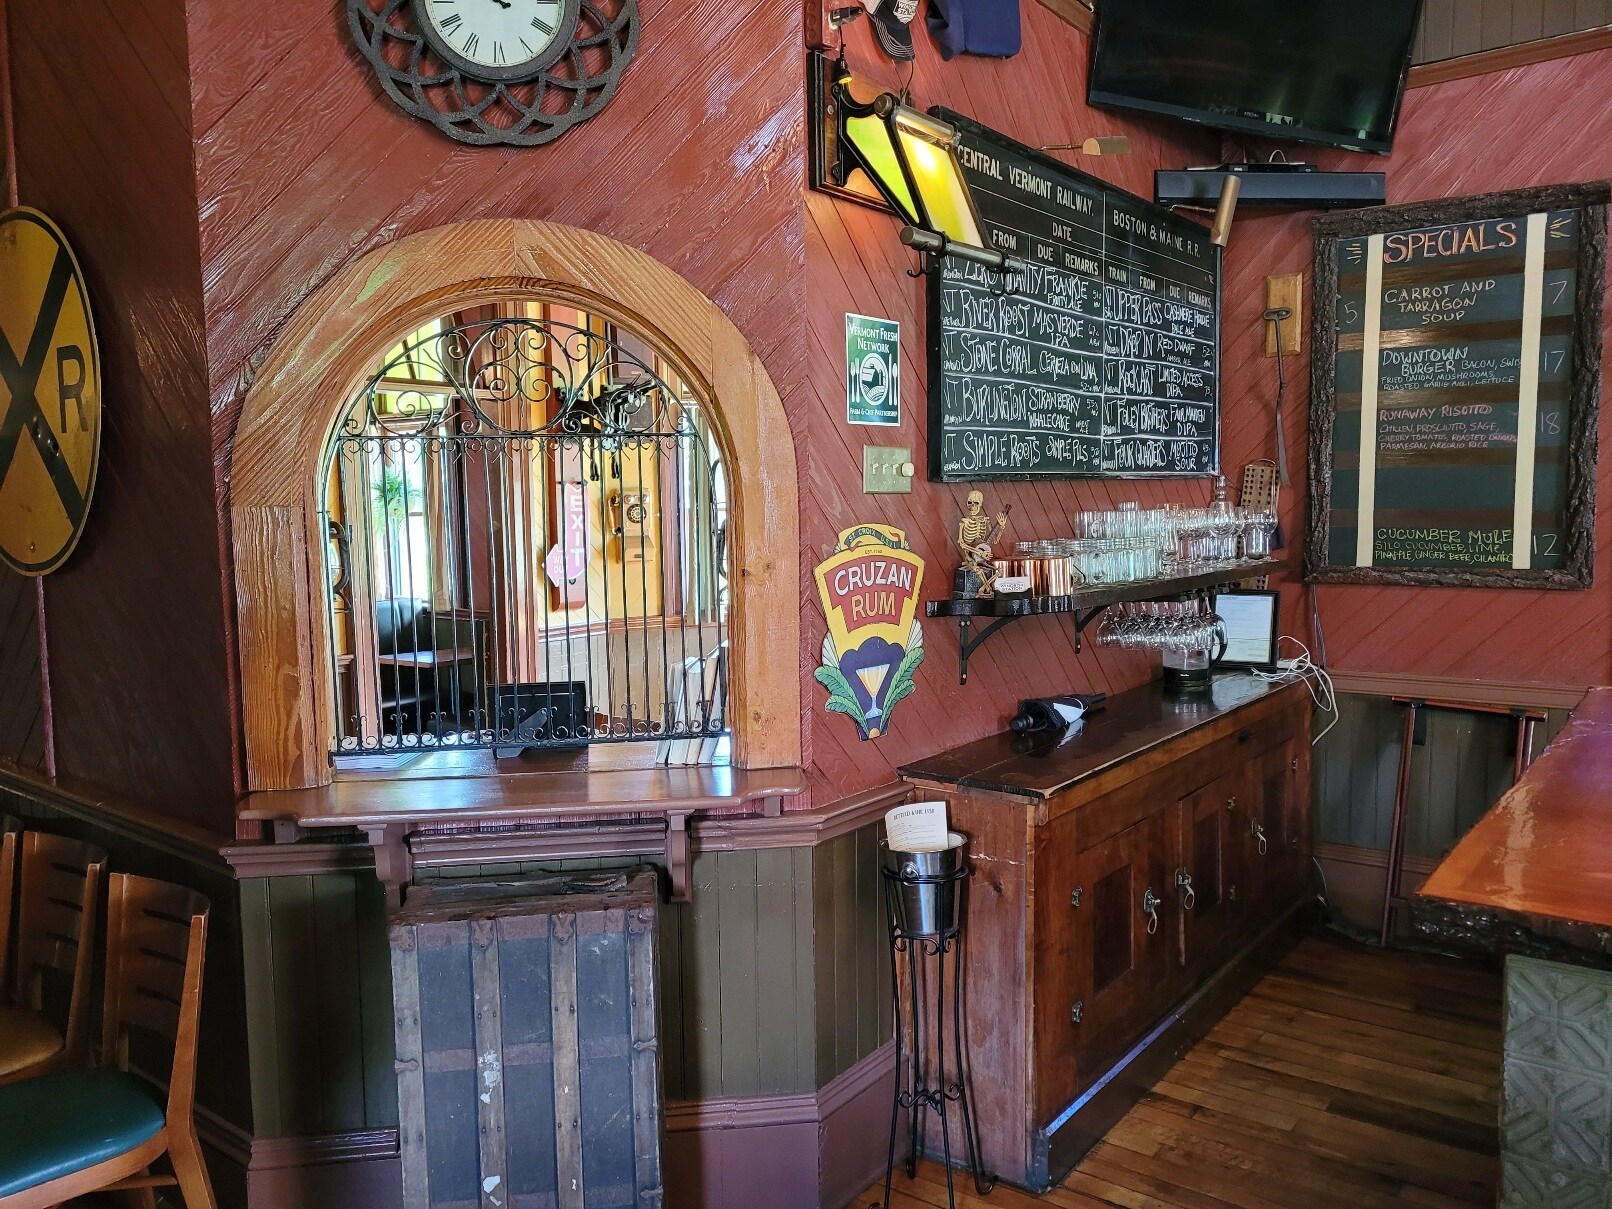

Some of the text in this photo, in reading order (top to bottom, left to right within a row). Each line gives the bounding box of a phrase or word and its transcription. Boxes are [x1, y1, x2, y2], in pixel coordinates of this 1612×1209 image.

[957, 144, 1003, 180] CENTRAL
[1008, 165, 1052, 200] VERMONT
[1052, 222, 1072, 242] DATE
[1113, 210, 1147, 236] BOSTON
[1150, 225, 1158, 240] &
[1160, 229, 1184, 252] MAINE
[1383, 222, 1517, 264] SPECIALS
[992, 230, 1212, 308] FROM DUE REMARKS TRAIN FROM DUE REMARKS
[1044, 267, 1088, 299] FRANKIE
[1112, 287, 1141, 324] UPPER
[1142, 297, 1162, 325] PASS
[1384, 279, 1568, 304] CARROT AND 7
[1398, 294, 1477, 312] TARRAGON
[943, 290, 958, 312] VT
[960, 289, 997, 332] RIVER
[998, 296, 1030, 337] ROOST
[1054, 314, 1084, 338] VERDE
[1422, 310, 1465, 325] SOUP
[848, 322, 898, 342] VERMONT FRESH
[1050, 332, 1070, 348] IPA
[1142, 328, 1154, 358] IN
[1157, 334, 1173, 358] RED
[1174, 340, 1196, 356] DWARF
[858, 340, 890, 354] NETWORK
[942, 331, 958, 358] VT
[960, 333, 998, 373] STONE
[1000, 338, 1038, 374] CORRAL
[1382, 346, 1566, 374] DOWNTOWN 17
[1119, 360, 1140, 394] ROCK
[1140, 364, 1156, 396] ART
[1381, 376, 1404, 384] FRIED
[1401, 359, 1456, 377] BURGER
[1462, 358, 1498, 370] BACON,
[57, 345, 88, 434] R
[1166, 383, 1183, 398] DIPA
[1383, 382, 1420, 391] ROASTED
[1476, 376, 1515, 385] LETTUCE
[874, 409, 898, 417] PARTNERSHIP
[944, 377, 1080, 425] VT BURLINGTON STRAWBERRY
[1117, 399, 1140, 433] FOLEY
[1177, 422, 1198, 437] DIPA
[1380, 404, 1561, 434] RUNAWAY RISOTTO 18
[962, 432, 1008, 470] SIMPLE
[1010, 434, 1040, 468] ROOTS
[1073, 438, 1088, 466] PILS
[1378, 434, 1410, 442] CHERRY
[1452, 433, 1486, 442] ROASTED
[1114, 439, 1134, 470] FOUR
[1169, 440, 1198, 460] MOJITO
[1175, 458, 1196, 470] SOUR
[570, 494, 584, 566] EXIT
[858, 528, 876, 536] CROIX
[1377, 528, 1560, 556] CUCUMBER MULE 12
[1375, 541, 1401, 550] SILO
[1405, 541, 1467, 553] CUCUMBER,
[834, 561, 912, 596] CRUZAN
[851, 592, 896, 622] RUM
